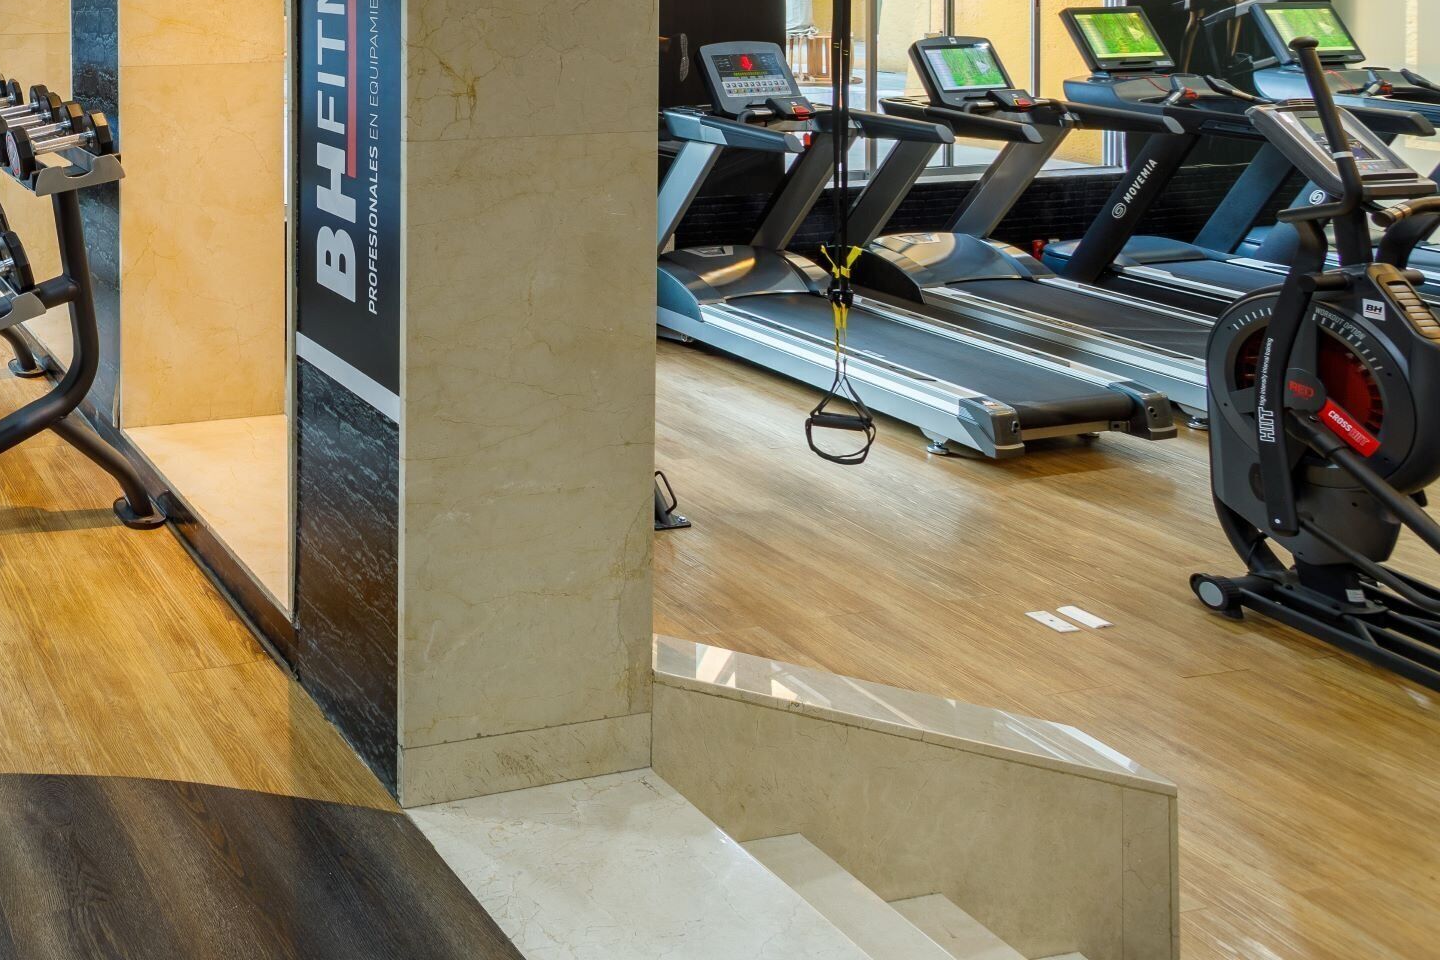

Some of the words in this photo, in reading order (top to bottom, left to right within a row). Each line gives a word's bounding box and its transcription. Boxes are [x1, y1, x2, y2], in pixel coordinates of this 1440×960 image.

[369, 113, 379, 140] EN
[1123, 158, 1158, 204] MOVEMIA
[368, 145, 379, 315] PROFESIONALES
[1315, 306, 1345, 325] WORKOUT
[1342, 321, 1367, 340] OPTION
[1366, 304, 1382, 313] BH
